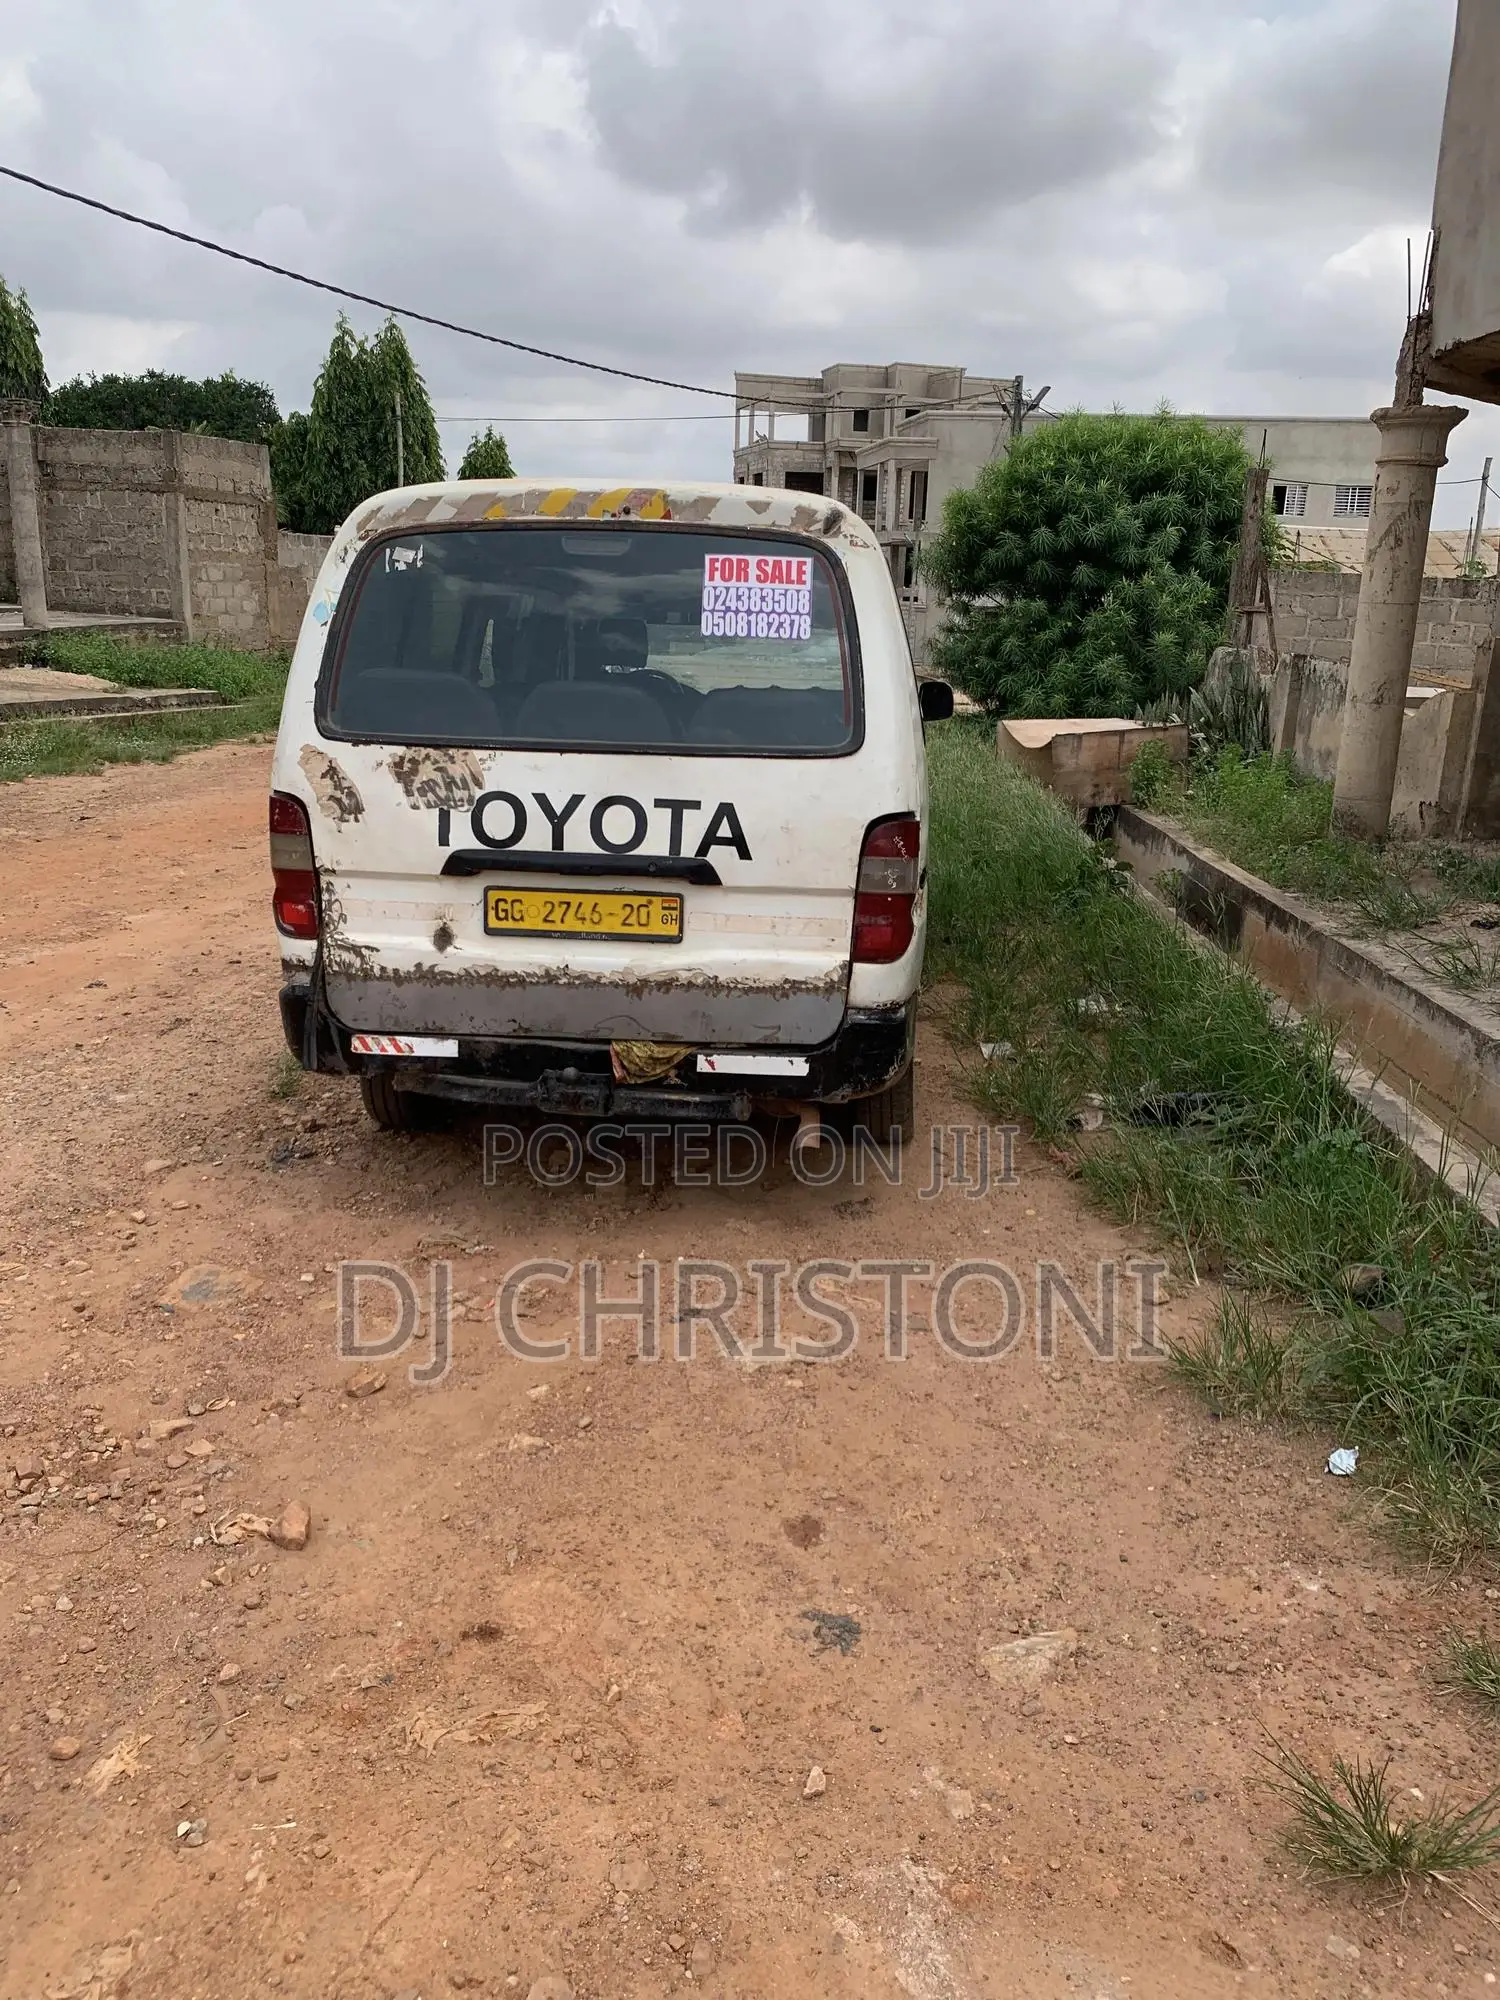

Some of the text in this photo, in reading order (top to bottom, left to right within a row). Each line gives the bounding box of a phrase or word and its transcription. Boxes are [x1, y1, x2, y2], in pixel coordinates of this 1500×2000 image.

[708, 557, 808, 585] FOR SALE
[703, 586, 810, 614] 024383508
[701, 611, 811, 640] 0508182378
[493, 898, 525, 922] GG
[661, 914, 678, 925] GH
